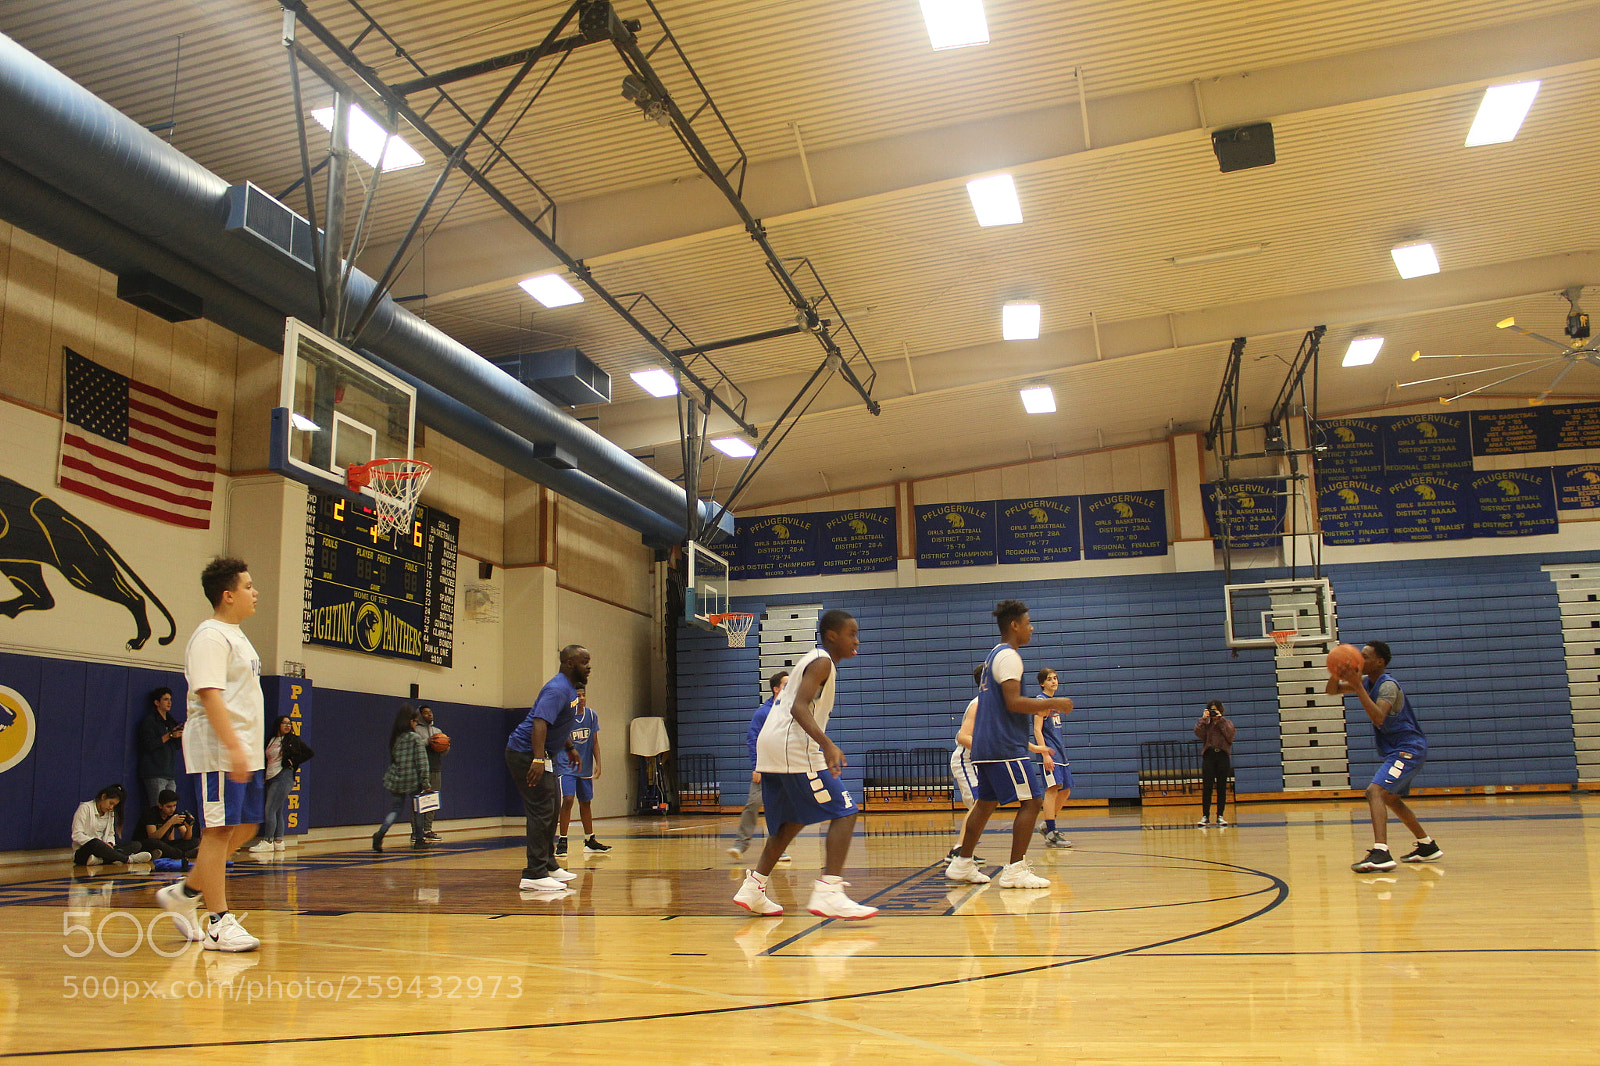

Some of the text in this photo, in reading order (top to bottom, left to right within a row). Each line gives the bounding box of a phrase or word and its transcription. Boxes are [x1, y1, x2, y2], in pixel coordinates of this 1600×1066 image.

[1391, 414, 1462, 432] PFLUGERVILLE
[1389, 476, 1460, 494] PFLUGERVILLE
[1472, 472, 1543, 489] PFLUGERVILLE
[334, 498, 345, 522] 2
[1005, 500, 1071, 517] PFLUGERVILLE
[1088, 494, 1156, 512] PFLUGERVILLE
[826, 512, 890, 530] PFLUGERVILLE
[922, 505, 988, 522] PFLUGERVILLE
[750, 516, 812, 534] PFLUGERVILLE
[370, 524, 378, 544] 4
[414, 520, 422, 548] 6
[322, 537, 338, 550] FOULS
[1044, 546, 1073, 554] FINALIST
[356, 548, 391, 565] PLAYER FOULS
[824, 556, 893, 567] DISTRICT CHAMPIONS
[920, 550, 994, 560] DISTRICT CHAMPIONS
[404, 562, 418, 572] FOULS
[778, 560, 816, 568] CHAMPIONS
[354, 590, 388, 604] HOME OF THE
[311, 600, 422, 656] IGHTING PANTHERS
